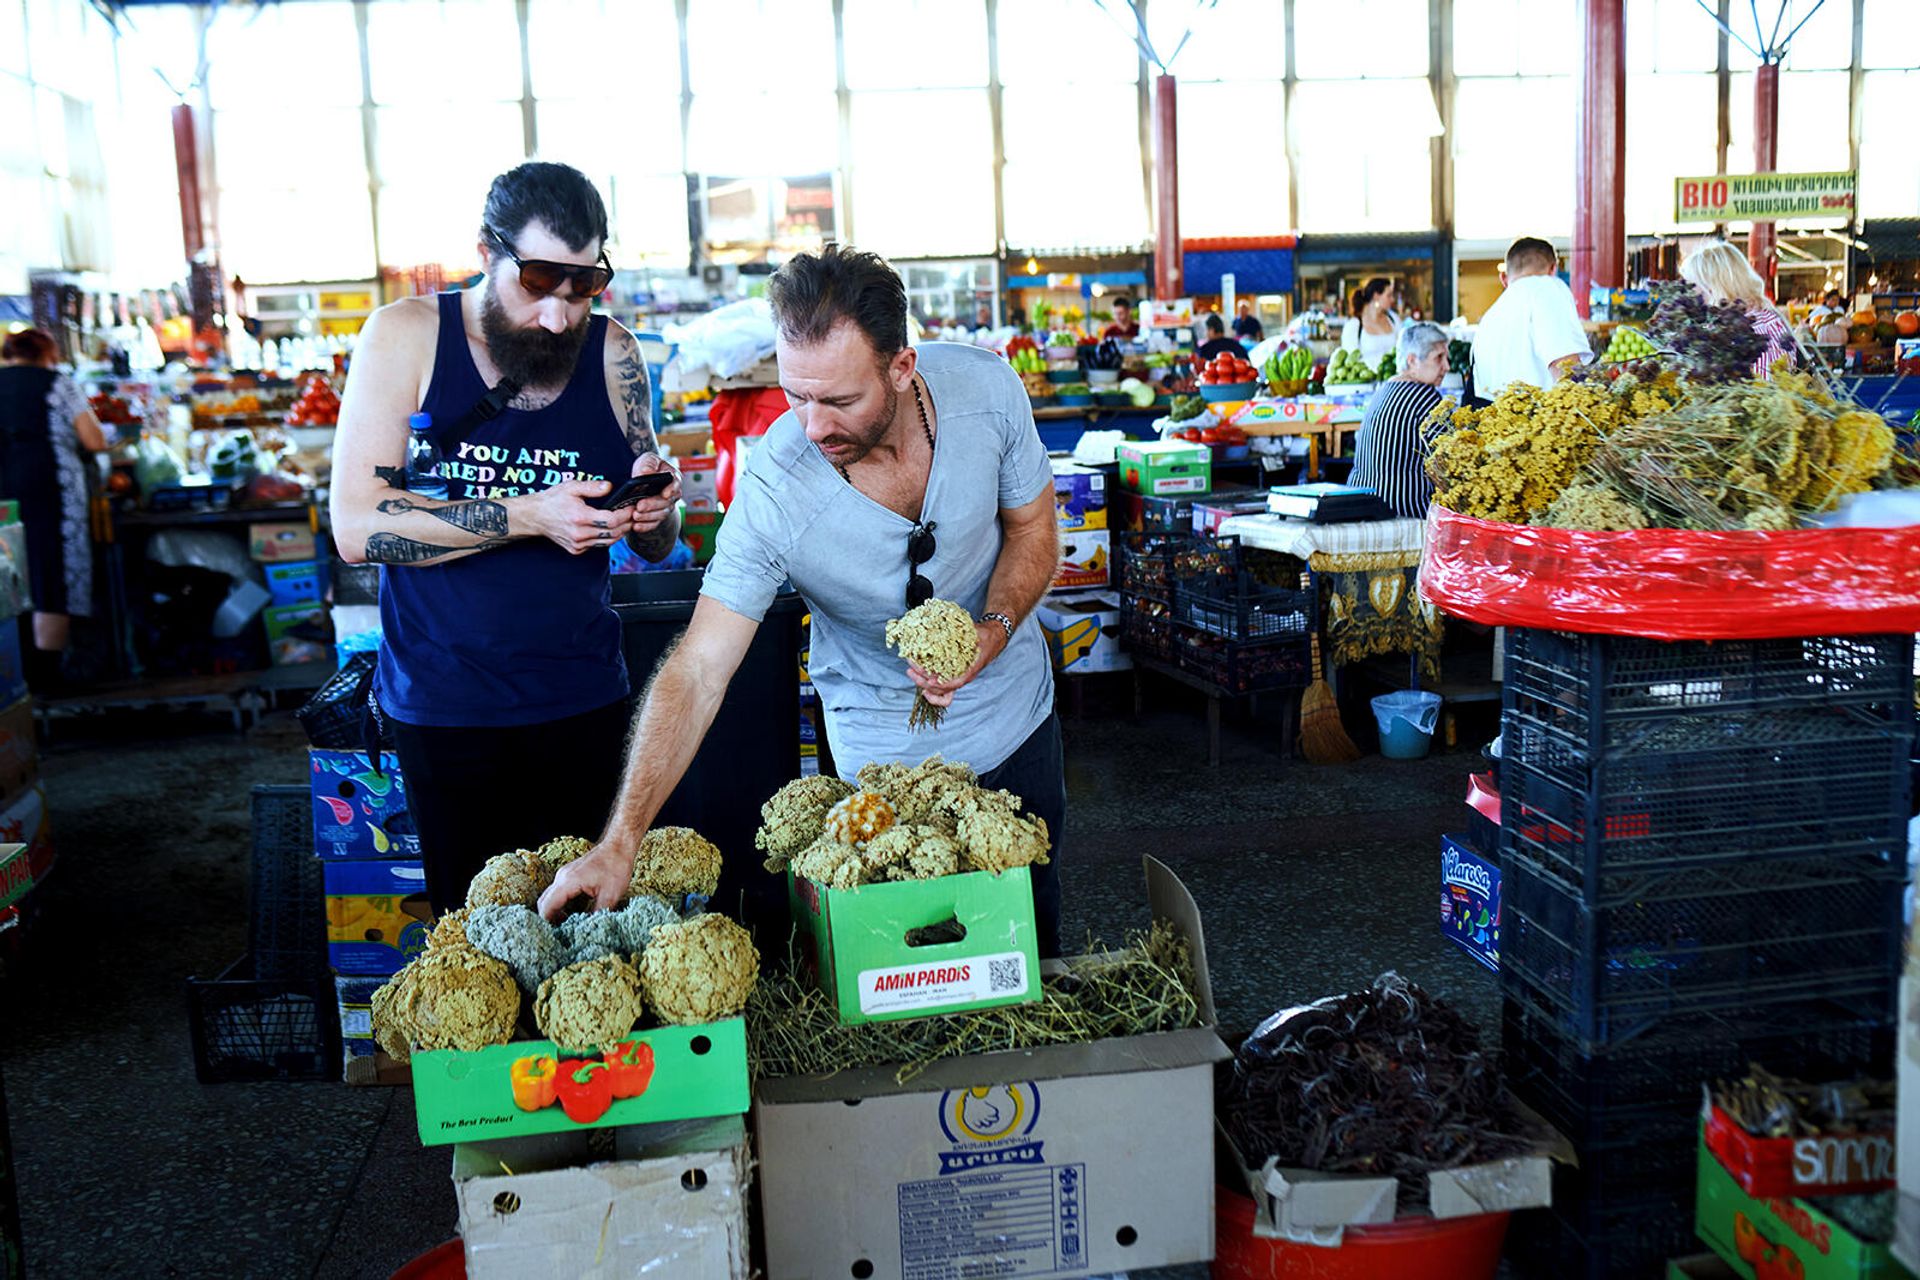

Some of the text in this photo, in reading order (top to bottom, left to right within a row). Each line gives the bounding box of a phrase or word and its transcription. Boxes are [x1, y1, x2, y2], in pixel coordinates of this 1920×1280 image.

[1683, 180, 1727, 208] BIO
[457, 442, 580, 467] YOU AIN'T
[502, 466, 536, 484] NO
[442, 1115, 513, 1130] The Best Product
